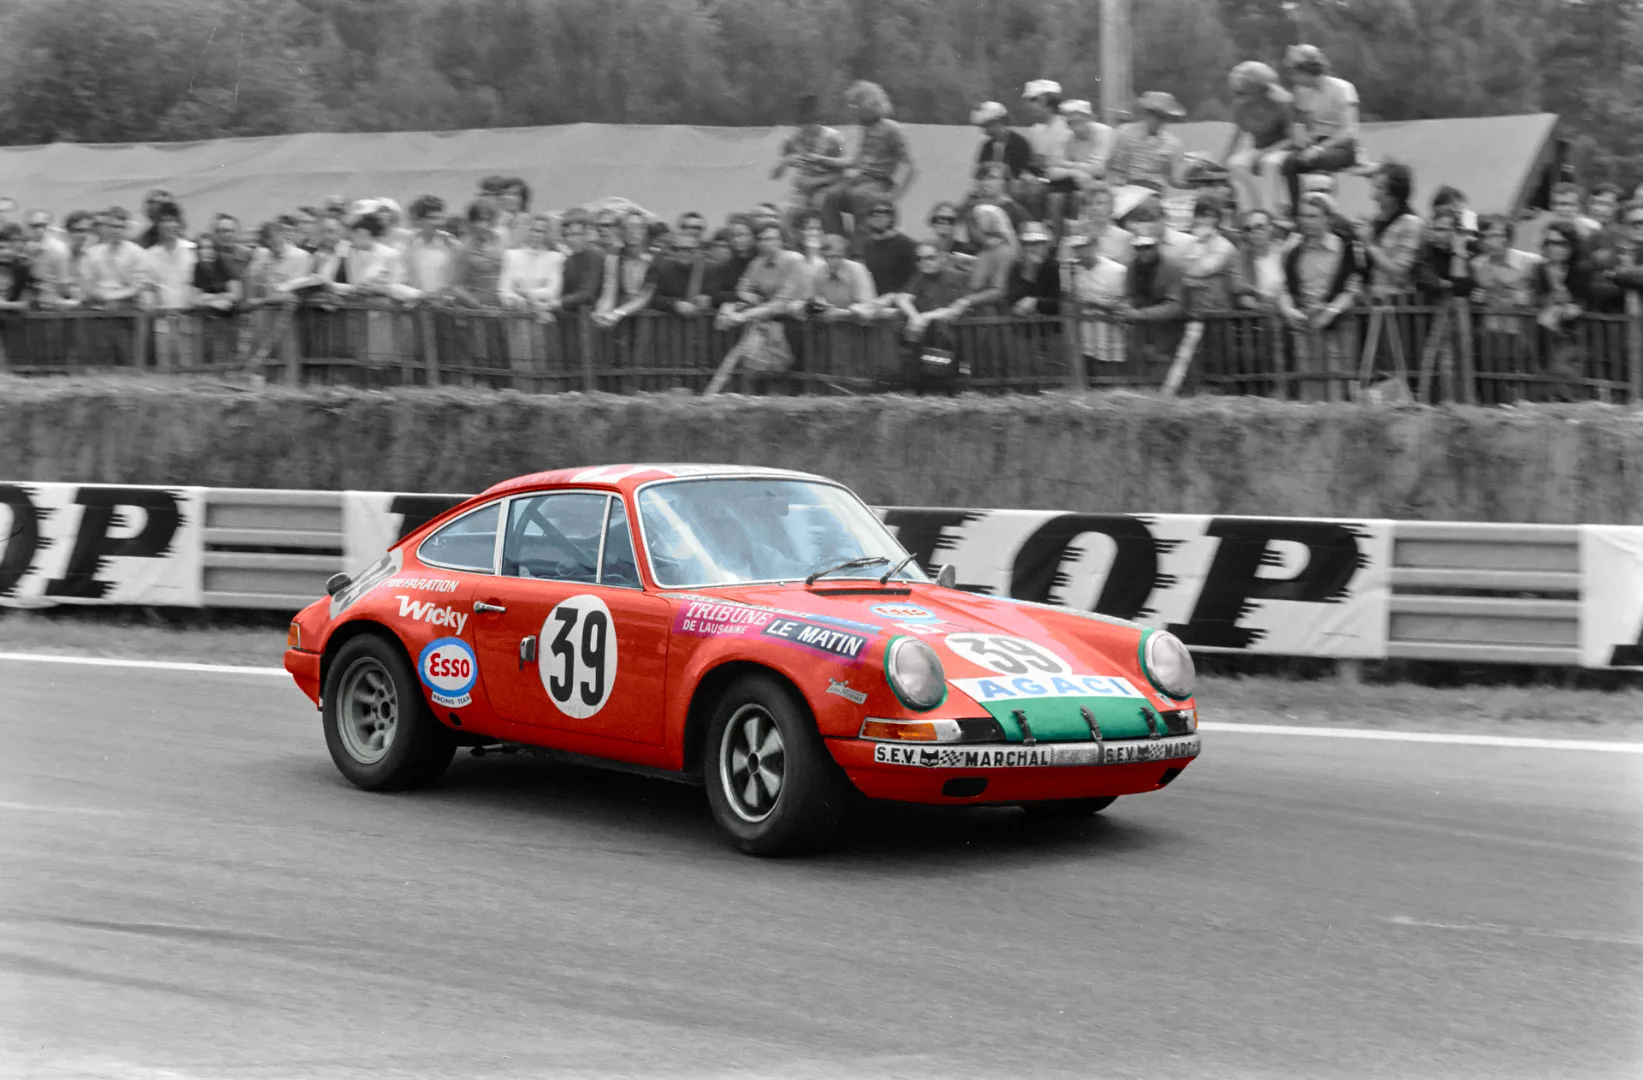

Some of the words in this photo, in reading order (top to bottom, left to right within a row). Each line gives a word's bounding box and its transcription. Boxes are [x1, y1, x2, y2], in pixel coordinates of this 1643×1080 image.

[394, 595, 468, 635] Wicky
[682, 619, 697, 631] DE
[699, 621, 749, 635] LAUSANNE
[686, 602, 775, 626] TRIBUNE
[766, 619, 797, 637] LE
[799, 626, 864, 656] MATIN
[550, 606, 608, 707] 39
[949, 638, 1063, 674] 39
[978, 677, 1132, 698] AGACI
[877, 747, 917, 765] S.E.V.
[965, 751, 1050, 767] MARCHAL
